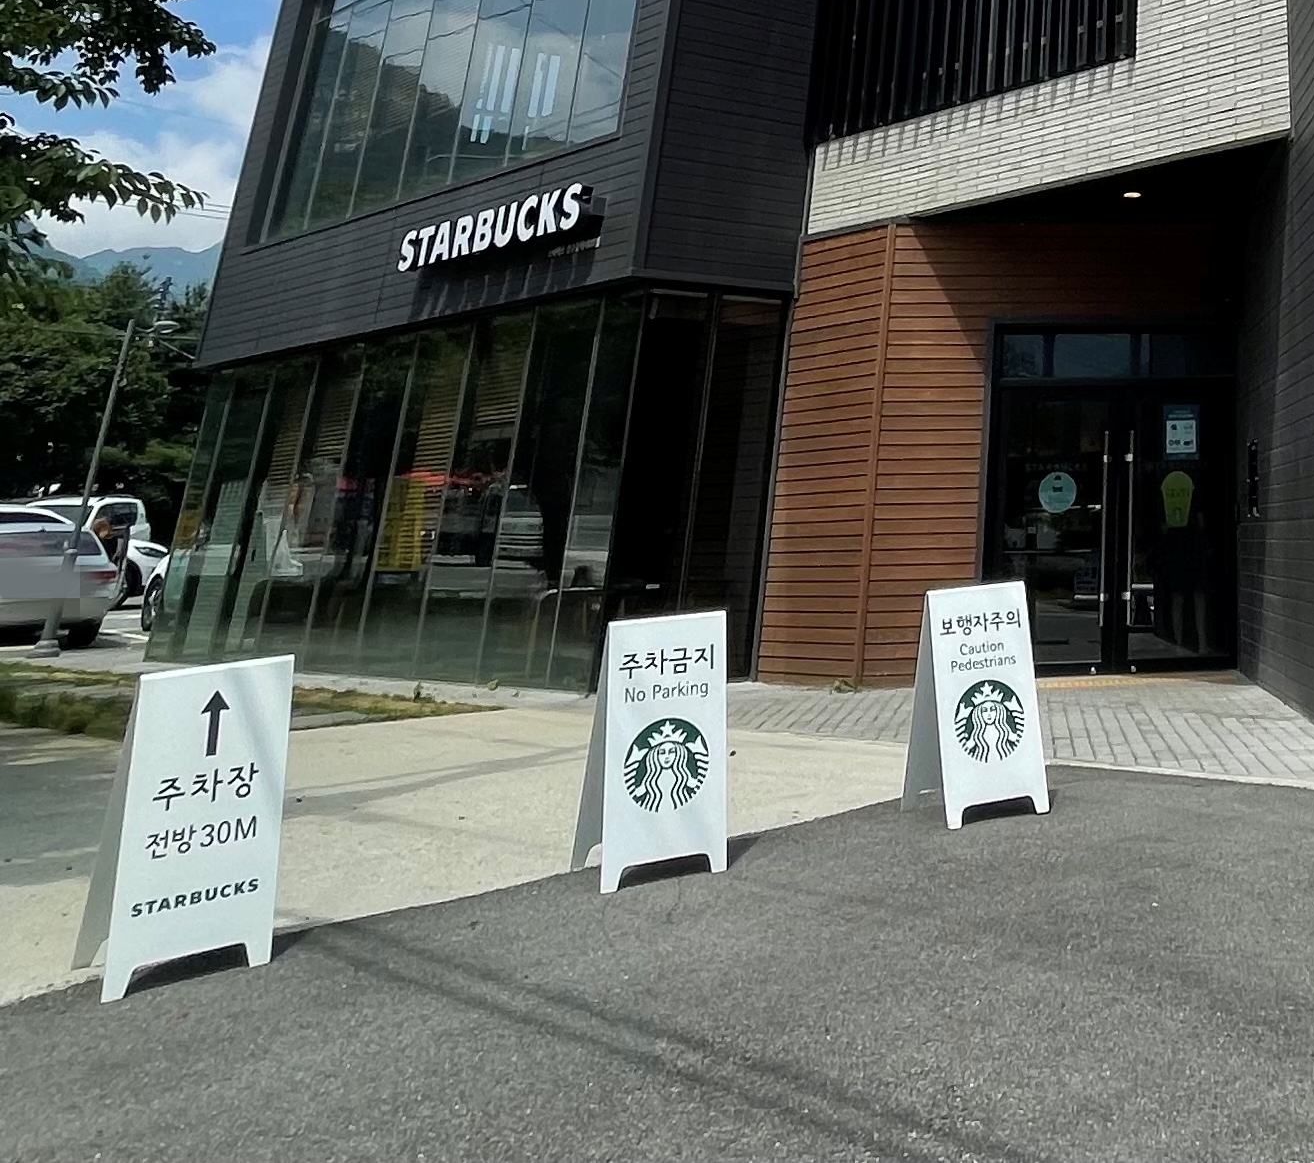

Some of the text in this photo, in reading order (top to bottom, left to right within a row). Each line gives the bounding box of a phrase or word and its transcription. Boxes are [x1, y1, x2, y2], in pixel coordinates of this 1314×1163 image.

[397, 183, 583, 272] STARBUCKS
[940, 608, 1021, 636] 보행자주의
[619, 643, 714, 679] 주차금지
[951, 655, 1016, 673] Pedestrians
[960, 641, 1004, 655] Caution
[624, 680, 709, 703] No Parking
[152, 762, 259, 811] 주차장
[131, 878, 259, 917] STARBUCKS
